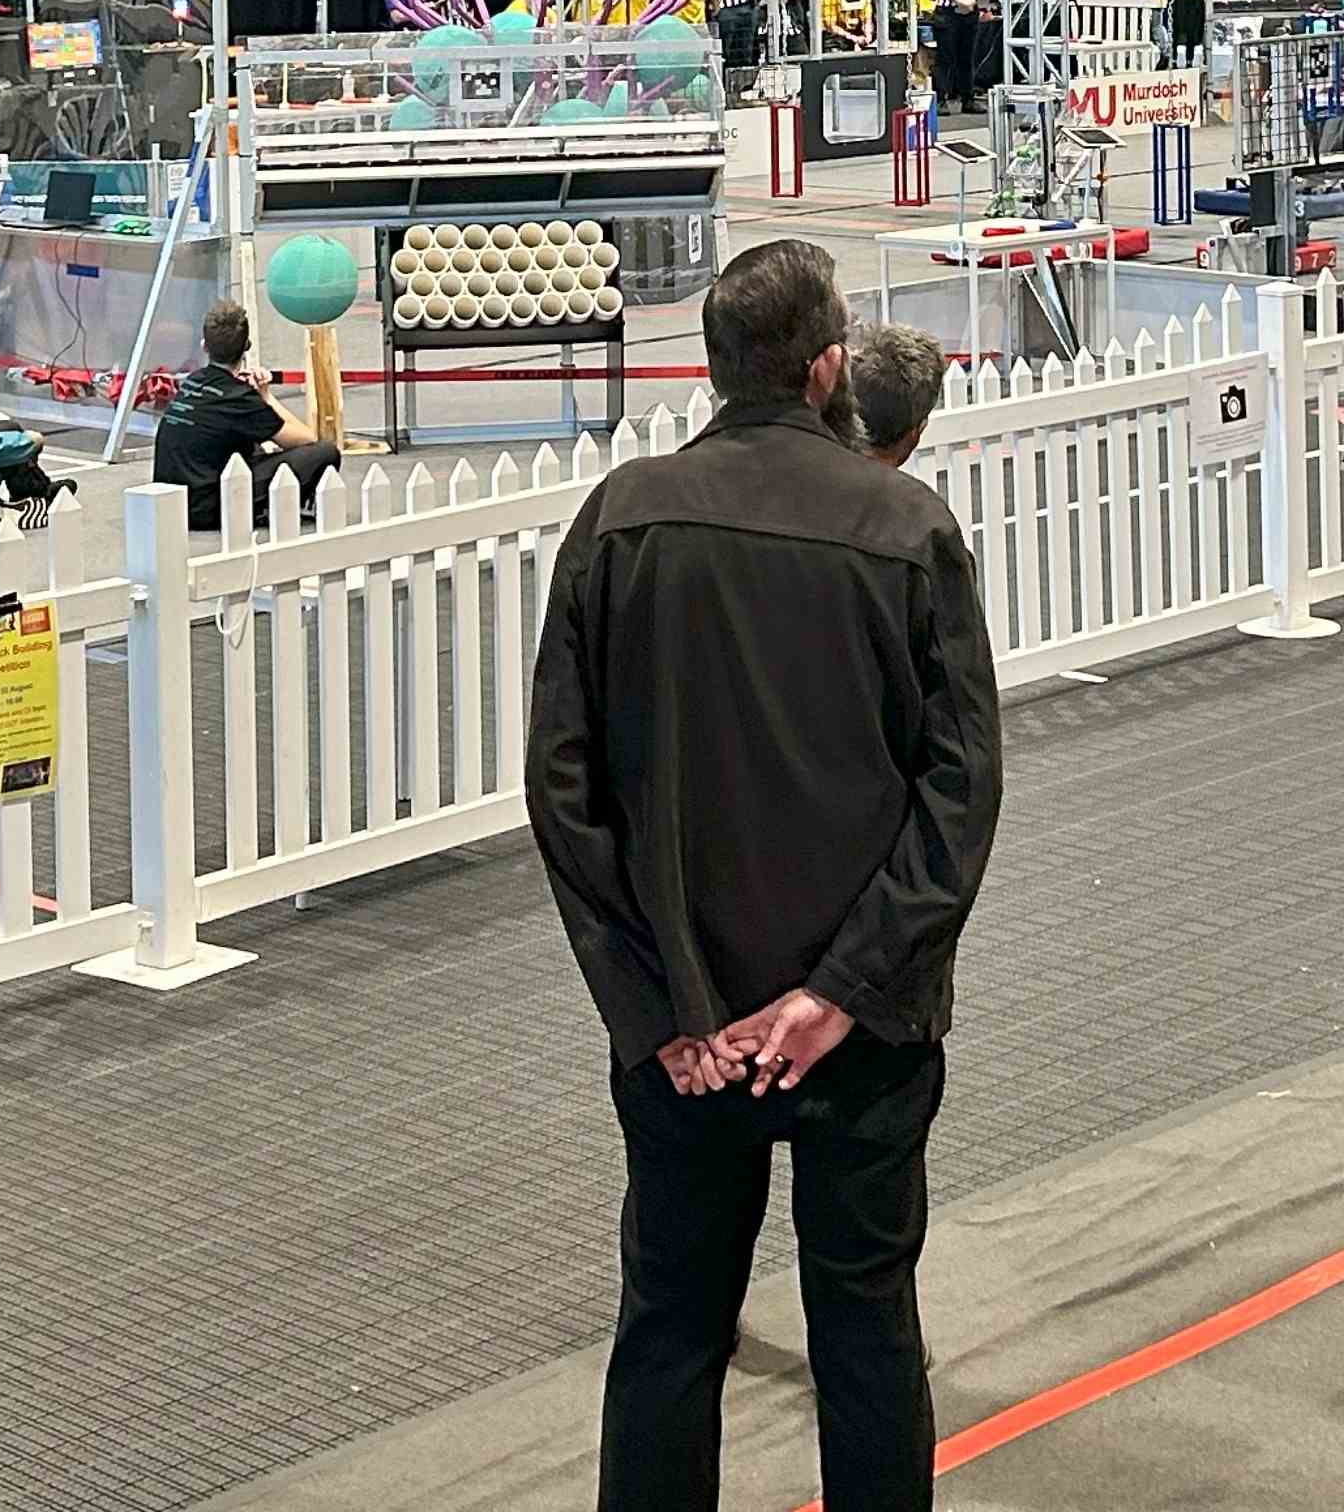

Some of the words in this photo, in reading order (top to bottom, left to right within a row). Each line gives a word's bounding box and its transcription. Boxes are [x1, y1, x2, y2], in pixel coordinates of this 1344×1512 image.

[1123, 79, 1188, 102] Murdoch
[1067, 85, 1116, 126] MU
[1123, 103, 1197, 126] University
